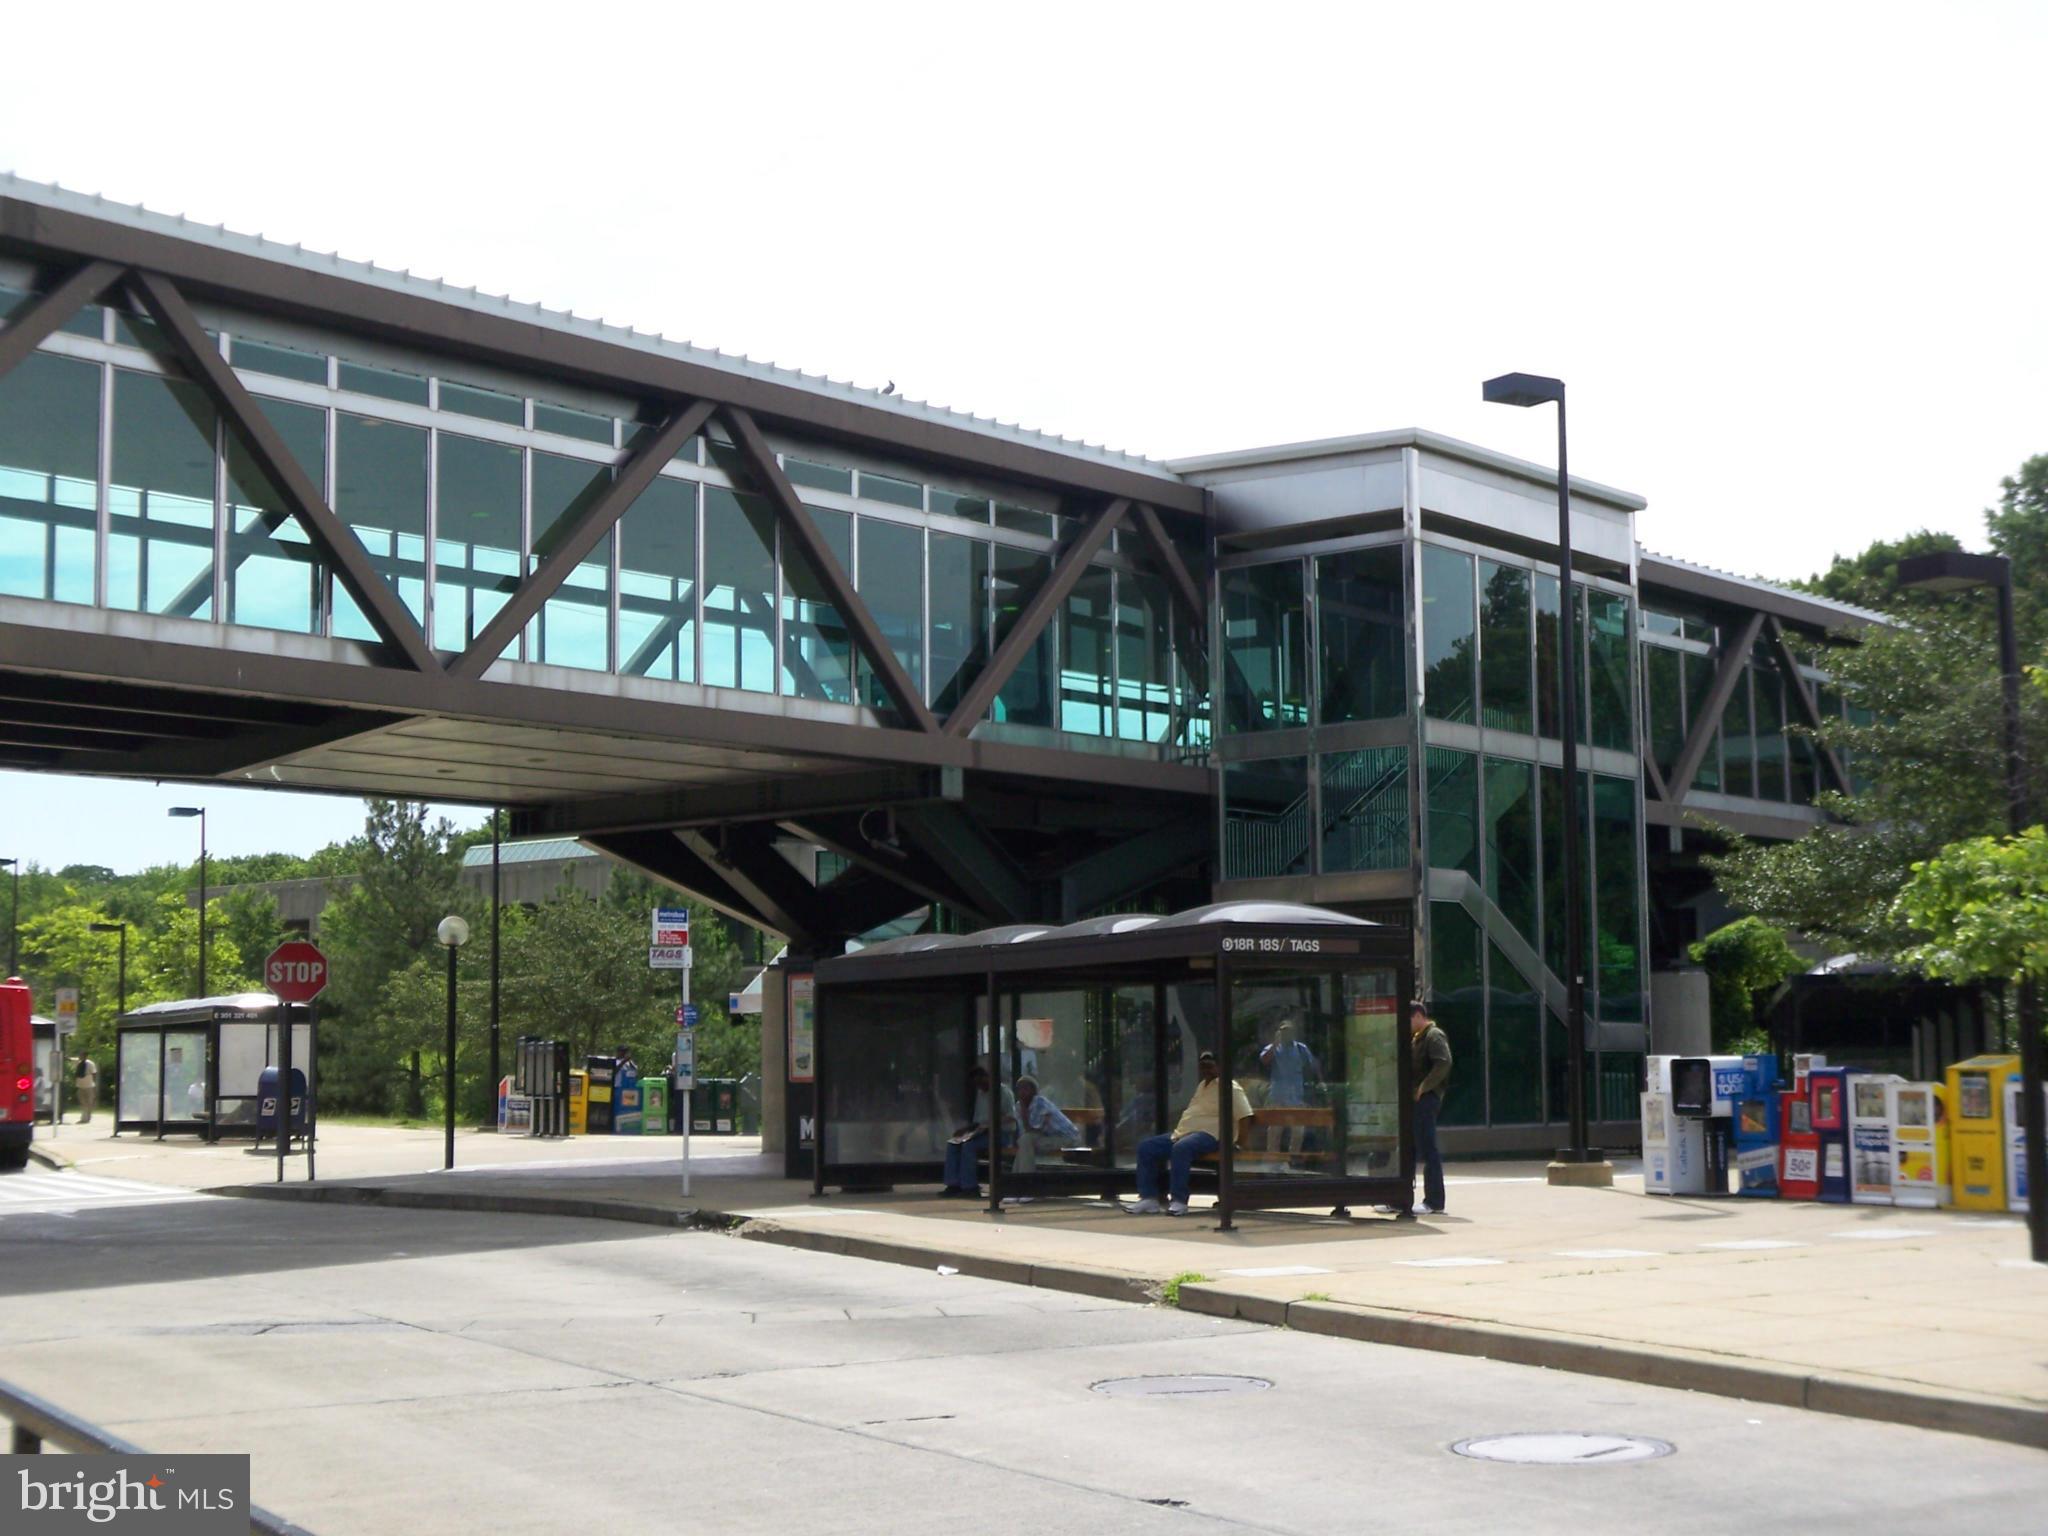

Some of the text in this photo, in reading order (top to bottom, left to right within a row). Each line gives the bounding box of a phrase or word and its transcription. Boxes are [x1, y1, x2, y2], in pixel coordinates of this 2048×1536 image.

[1290, 940, 1320, 952] TAGS
[651, 950, 683, 959] TAGS
[269, 961, 325, 983] STOP
